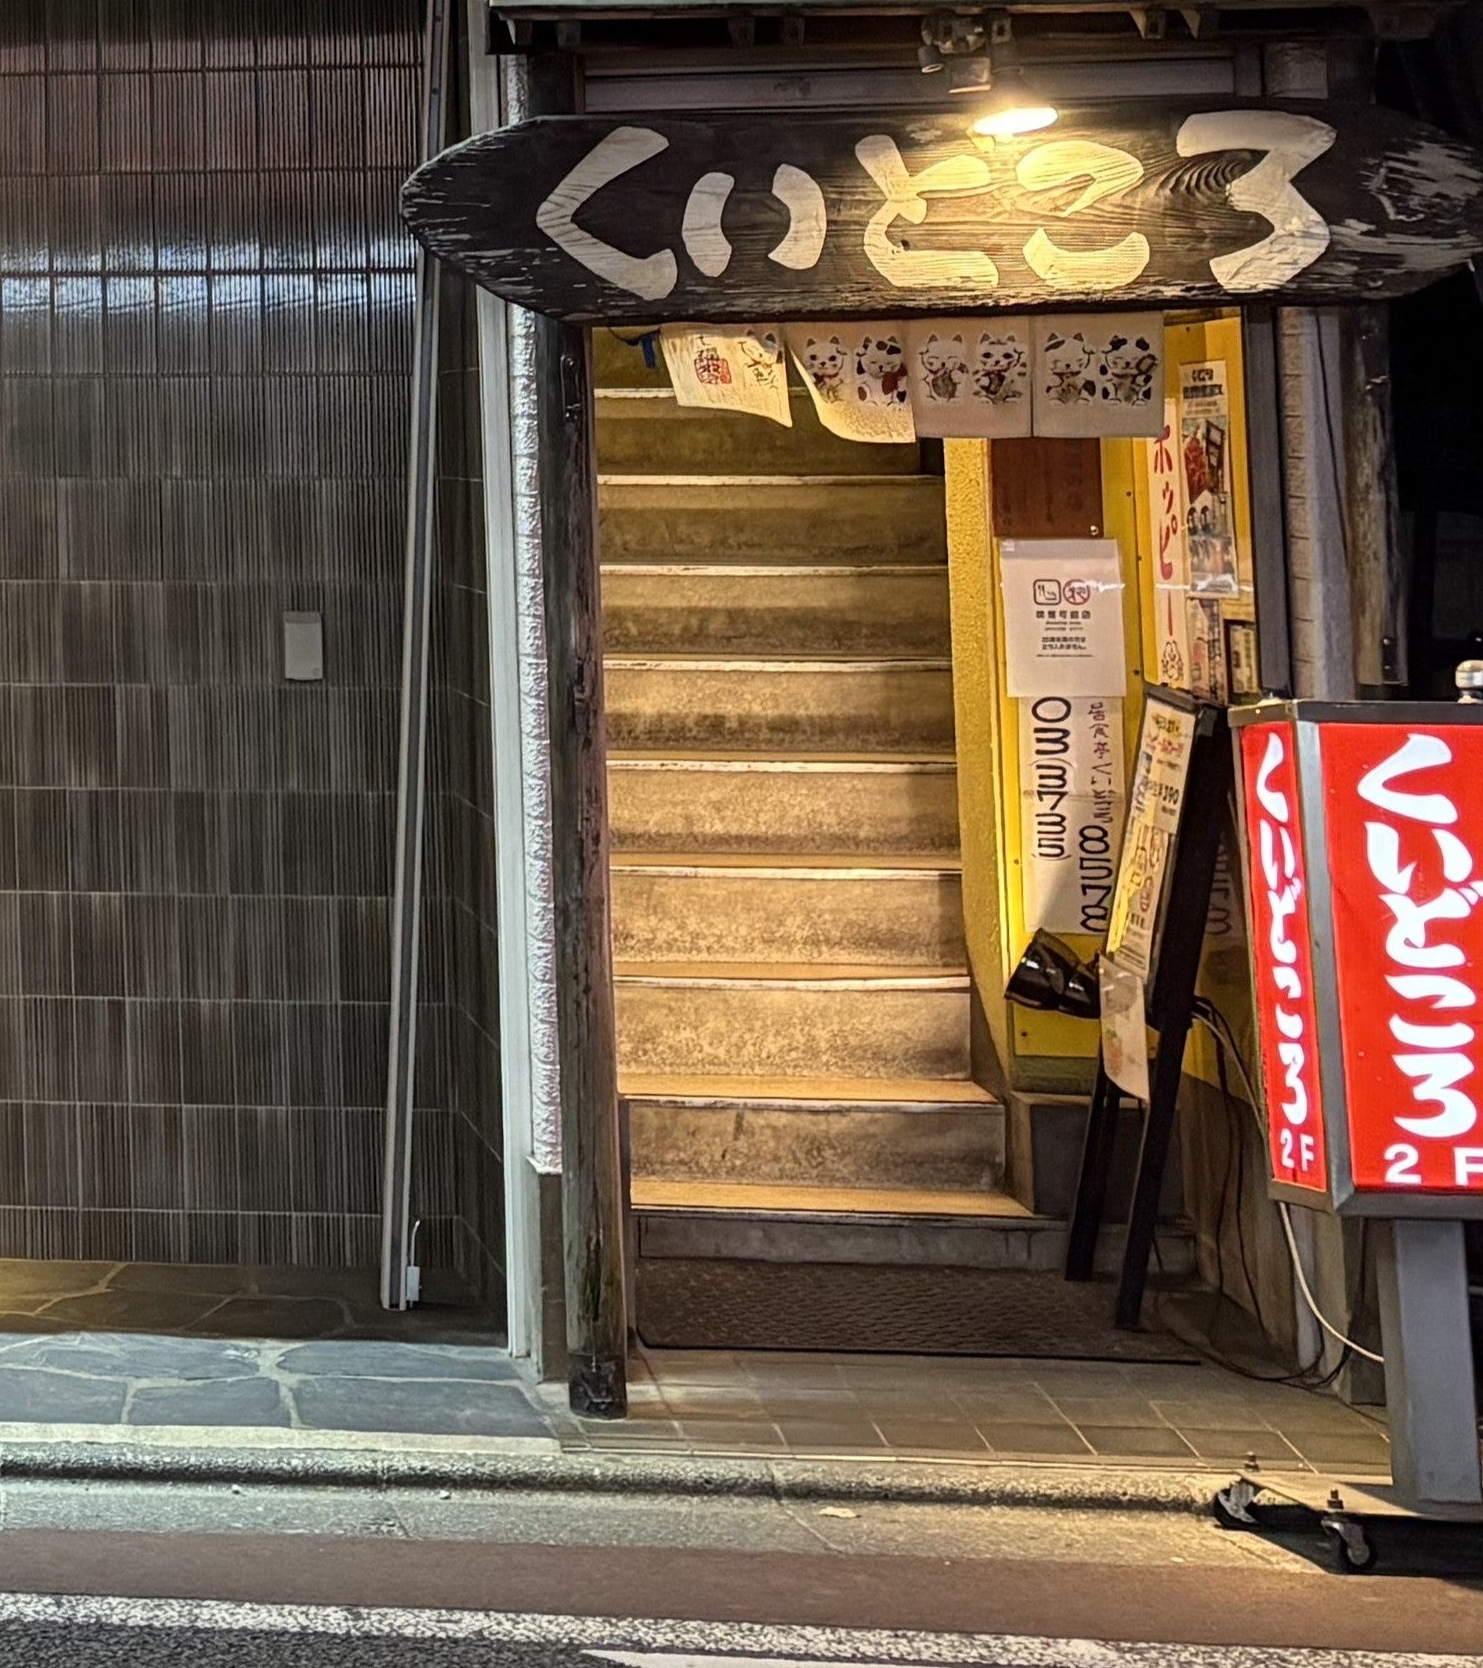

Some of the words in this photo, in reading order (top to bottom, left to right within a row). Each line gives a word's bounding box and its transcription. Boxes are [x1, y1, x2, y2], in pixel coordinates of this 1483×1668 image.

[1256, 733, 1302, 1126] くいどころ
[1356, 733, 1483, 1138] くいどころ
[1279, 1128, 1315, 1172] 2F
[1385, 1143, 1483, 1186] 2F
